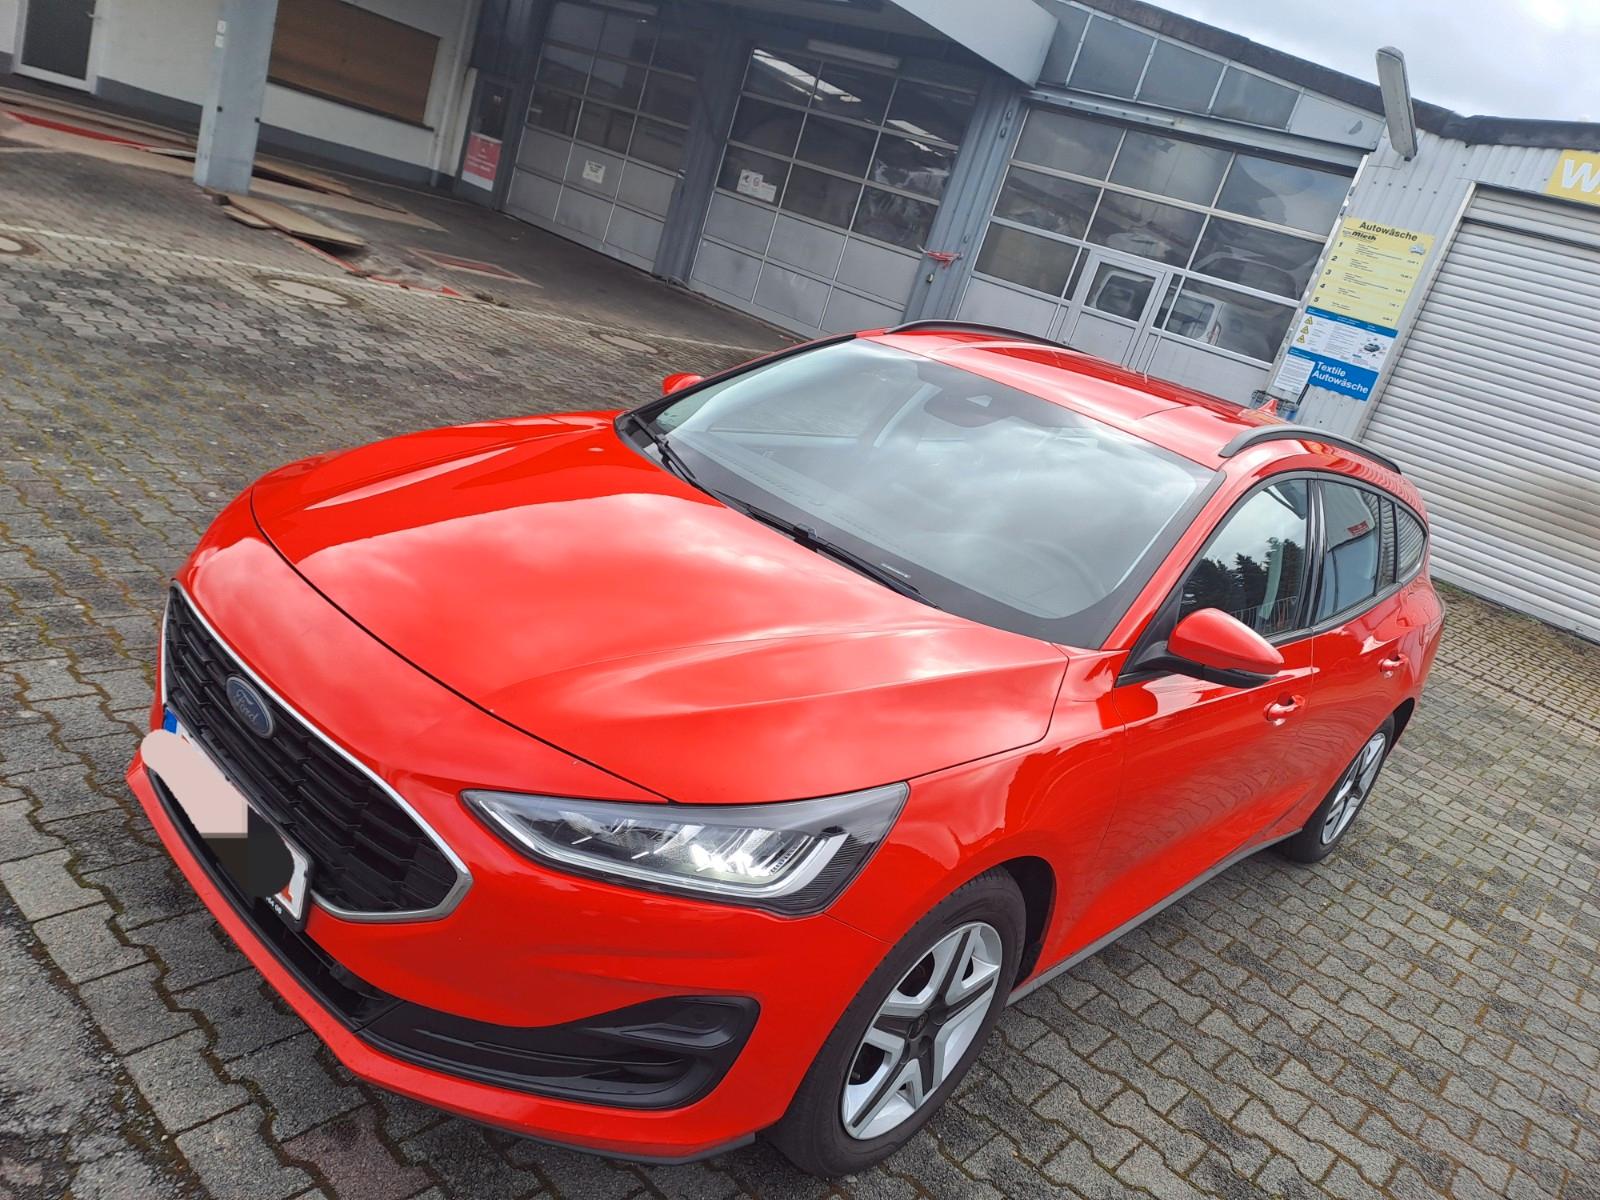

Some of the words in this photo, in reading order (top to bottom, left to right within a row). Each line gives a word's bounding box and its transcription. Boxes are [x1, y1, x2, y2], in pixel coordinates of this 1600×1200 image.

[1359, 221, 1418, 242] Autowäsche
[1317, 361, 1347, 377] Textile
[1312, 370, 1369, 394] Autowäsche
[232, 689, 260, 722] Ford
